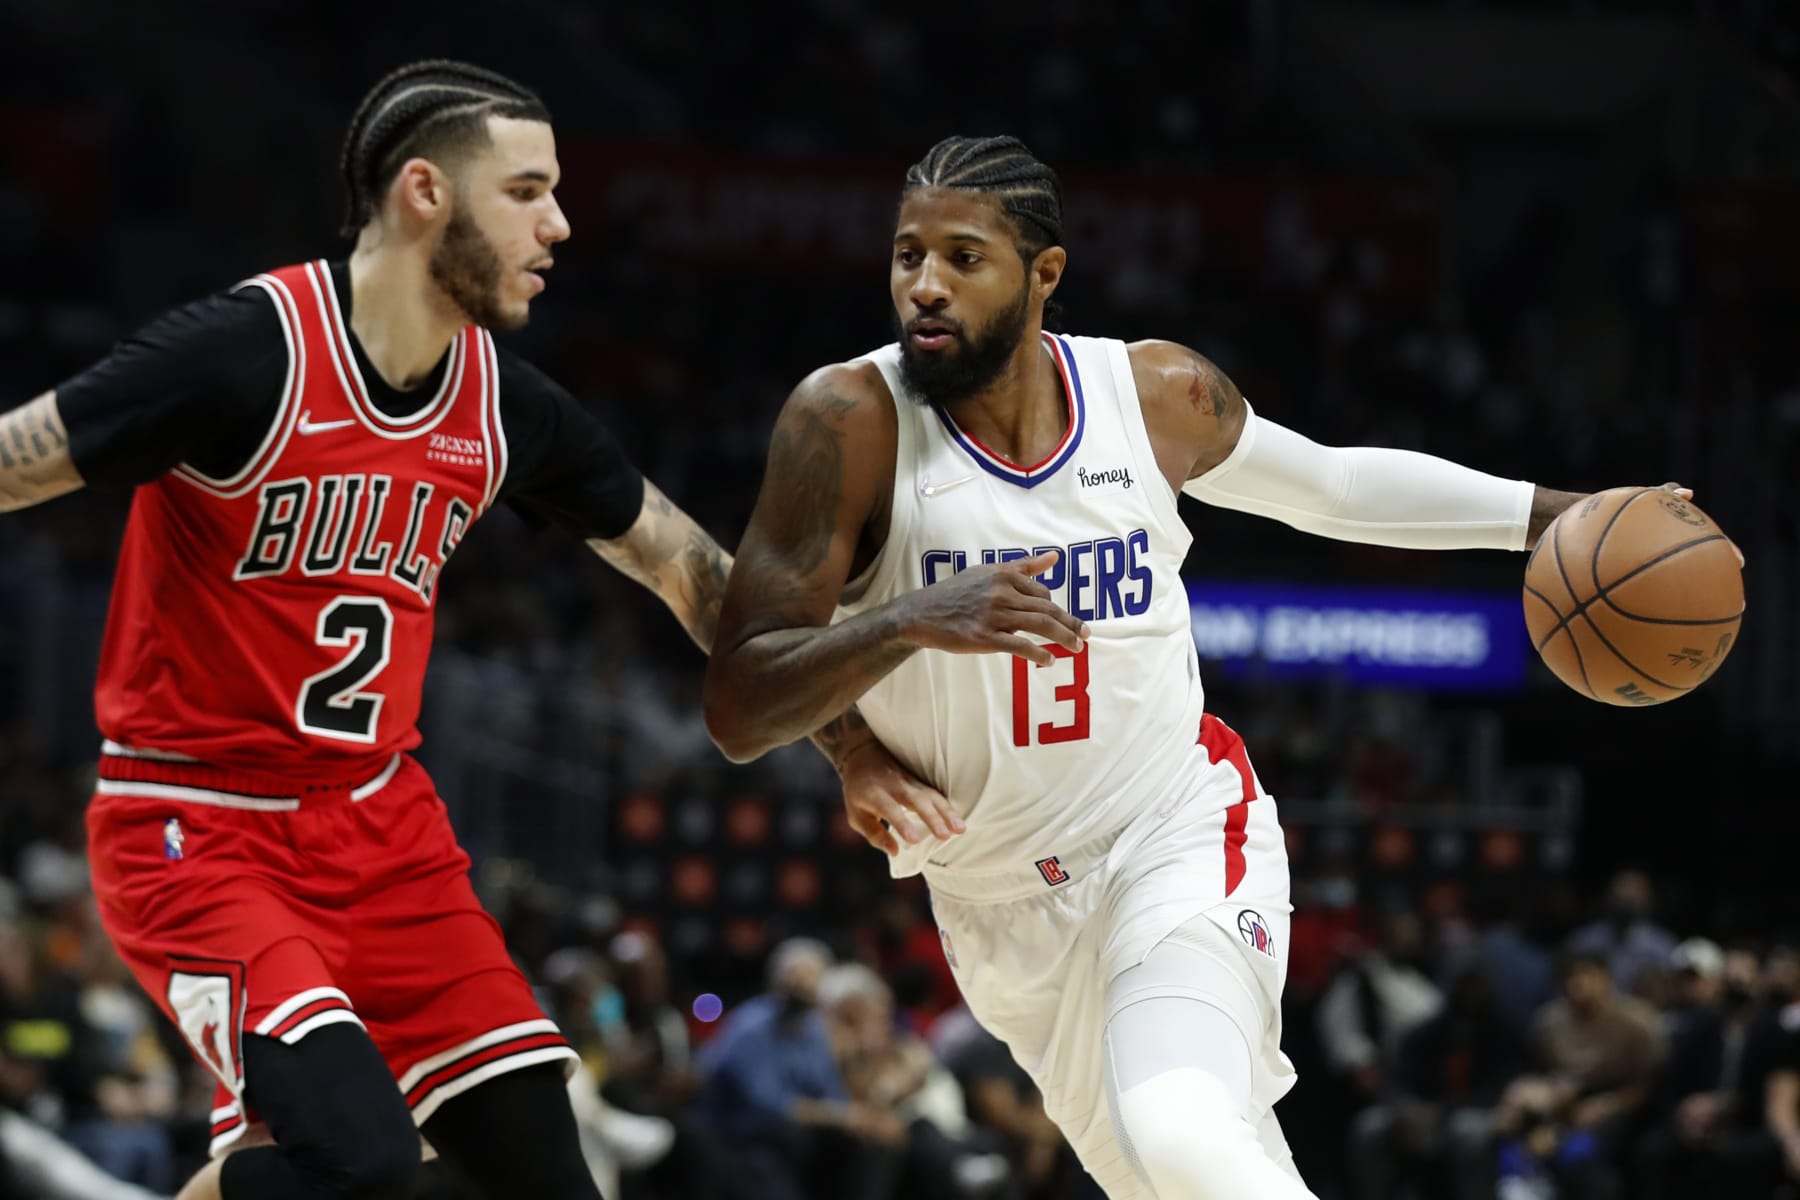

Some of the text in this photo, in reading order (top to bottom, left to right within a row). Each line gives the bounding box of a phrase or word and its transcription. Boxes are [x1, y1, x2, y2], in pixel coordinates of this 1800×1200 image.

[426, 449, 484, 467] EYEWEAR
[1077, 467, 1134, 489] honey
[233, 473, 473, 606] BULLS
[921, 528, 1153, 622] PERS
[295, 595, 394, 744] 2
[1012, 641, 1090, 747] 13
